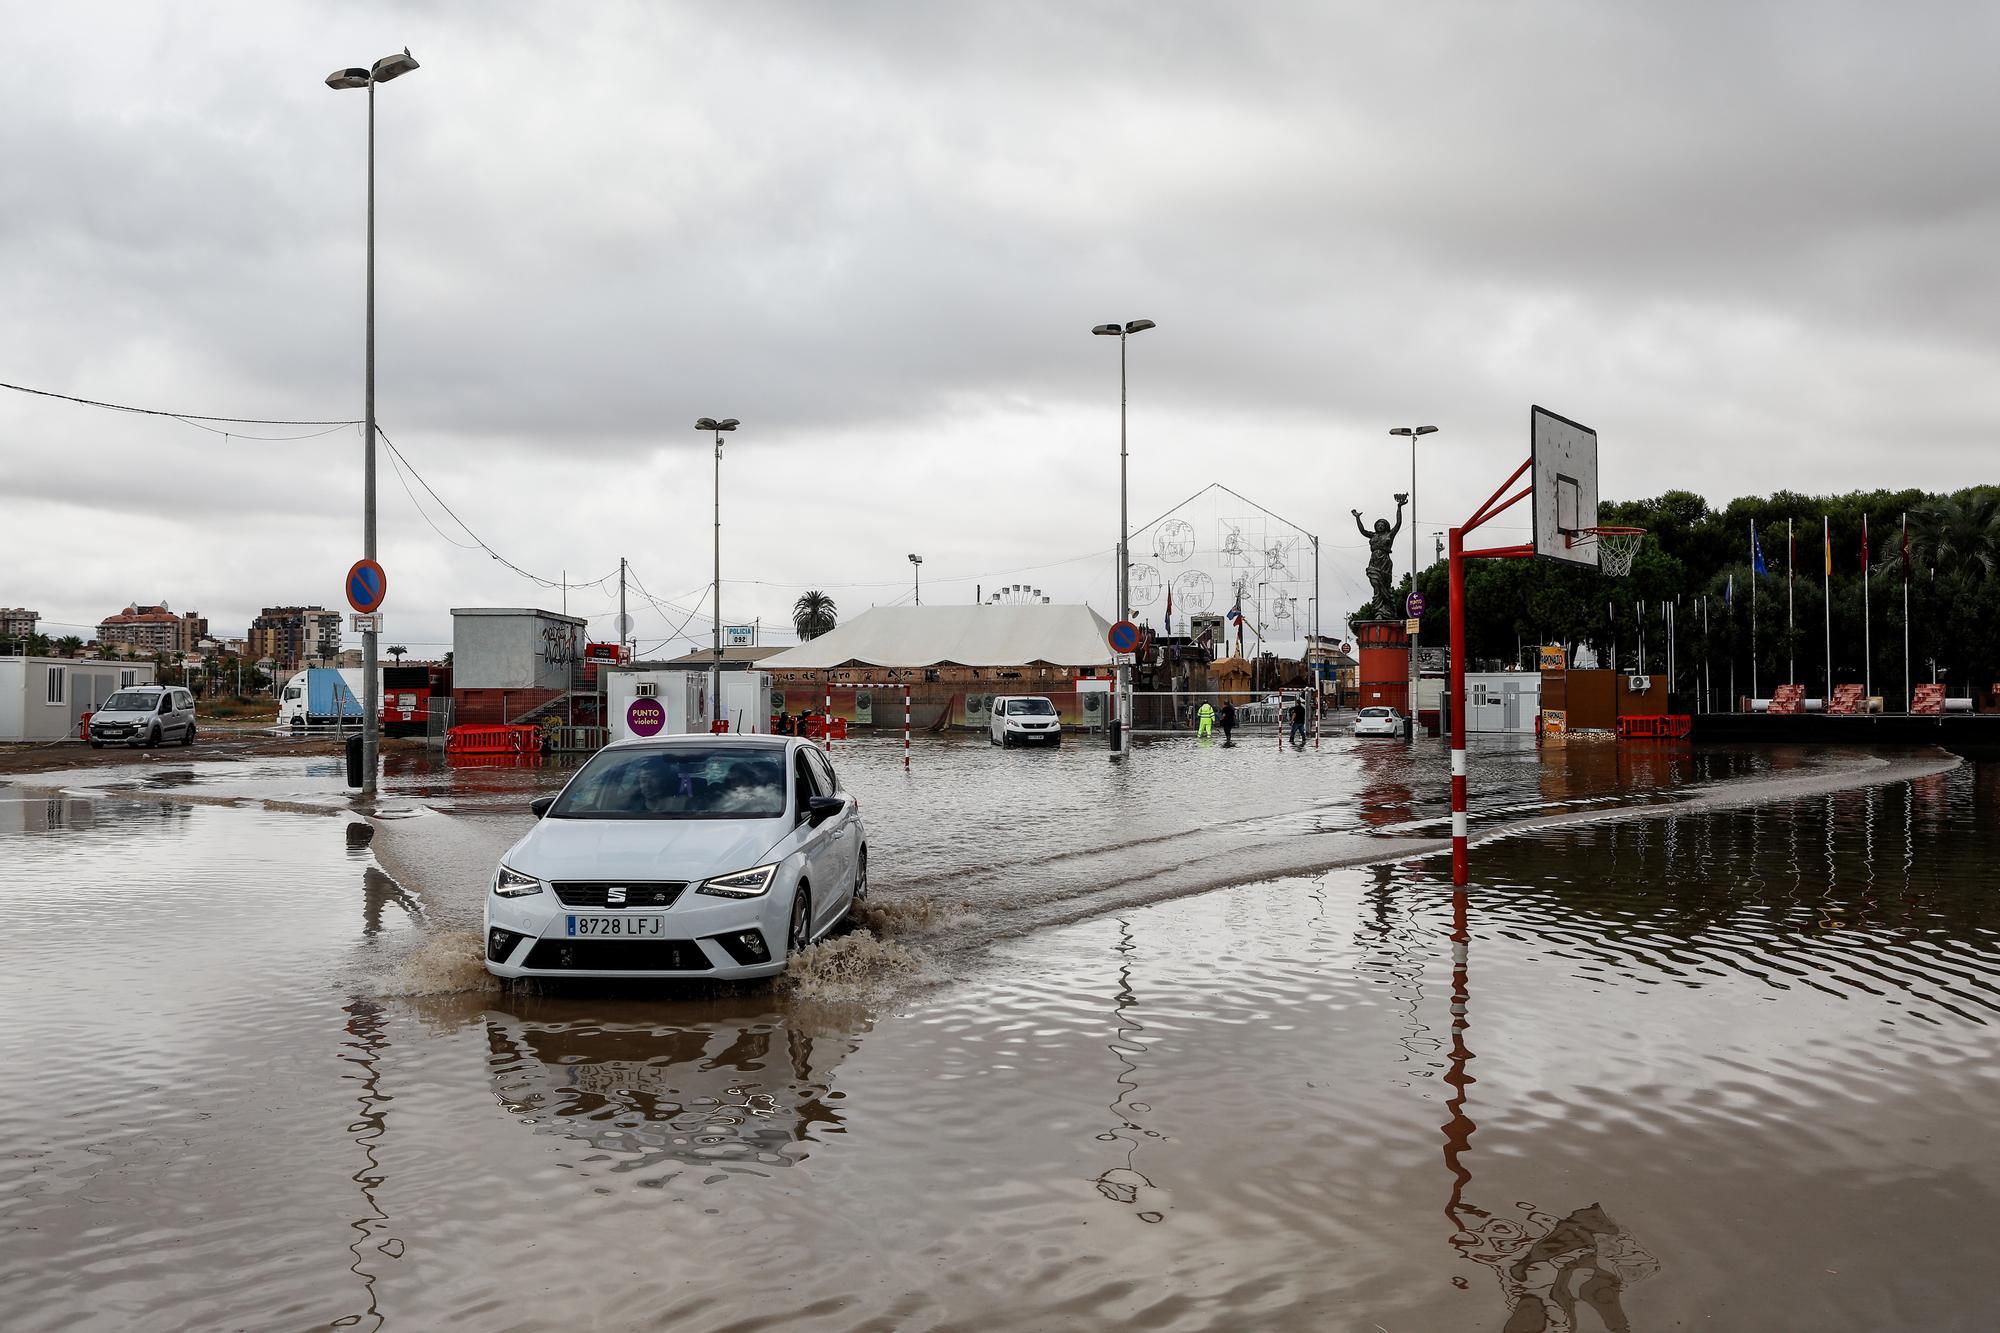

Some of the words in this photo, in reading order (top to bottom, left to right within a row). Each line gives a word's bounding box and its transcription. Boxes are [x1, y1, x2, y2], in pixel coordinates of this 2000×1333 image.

[632, 709, 660, 717] PUNTO
[633, 717, 659, 725] violeta
[579, 918, 621, 934] 8728
[627, 918, 659, 935] LFJ
